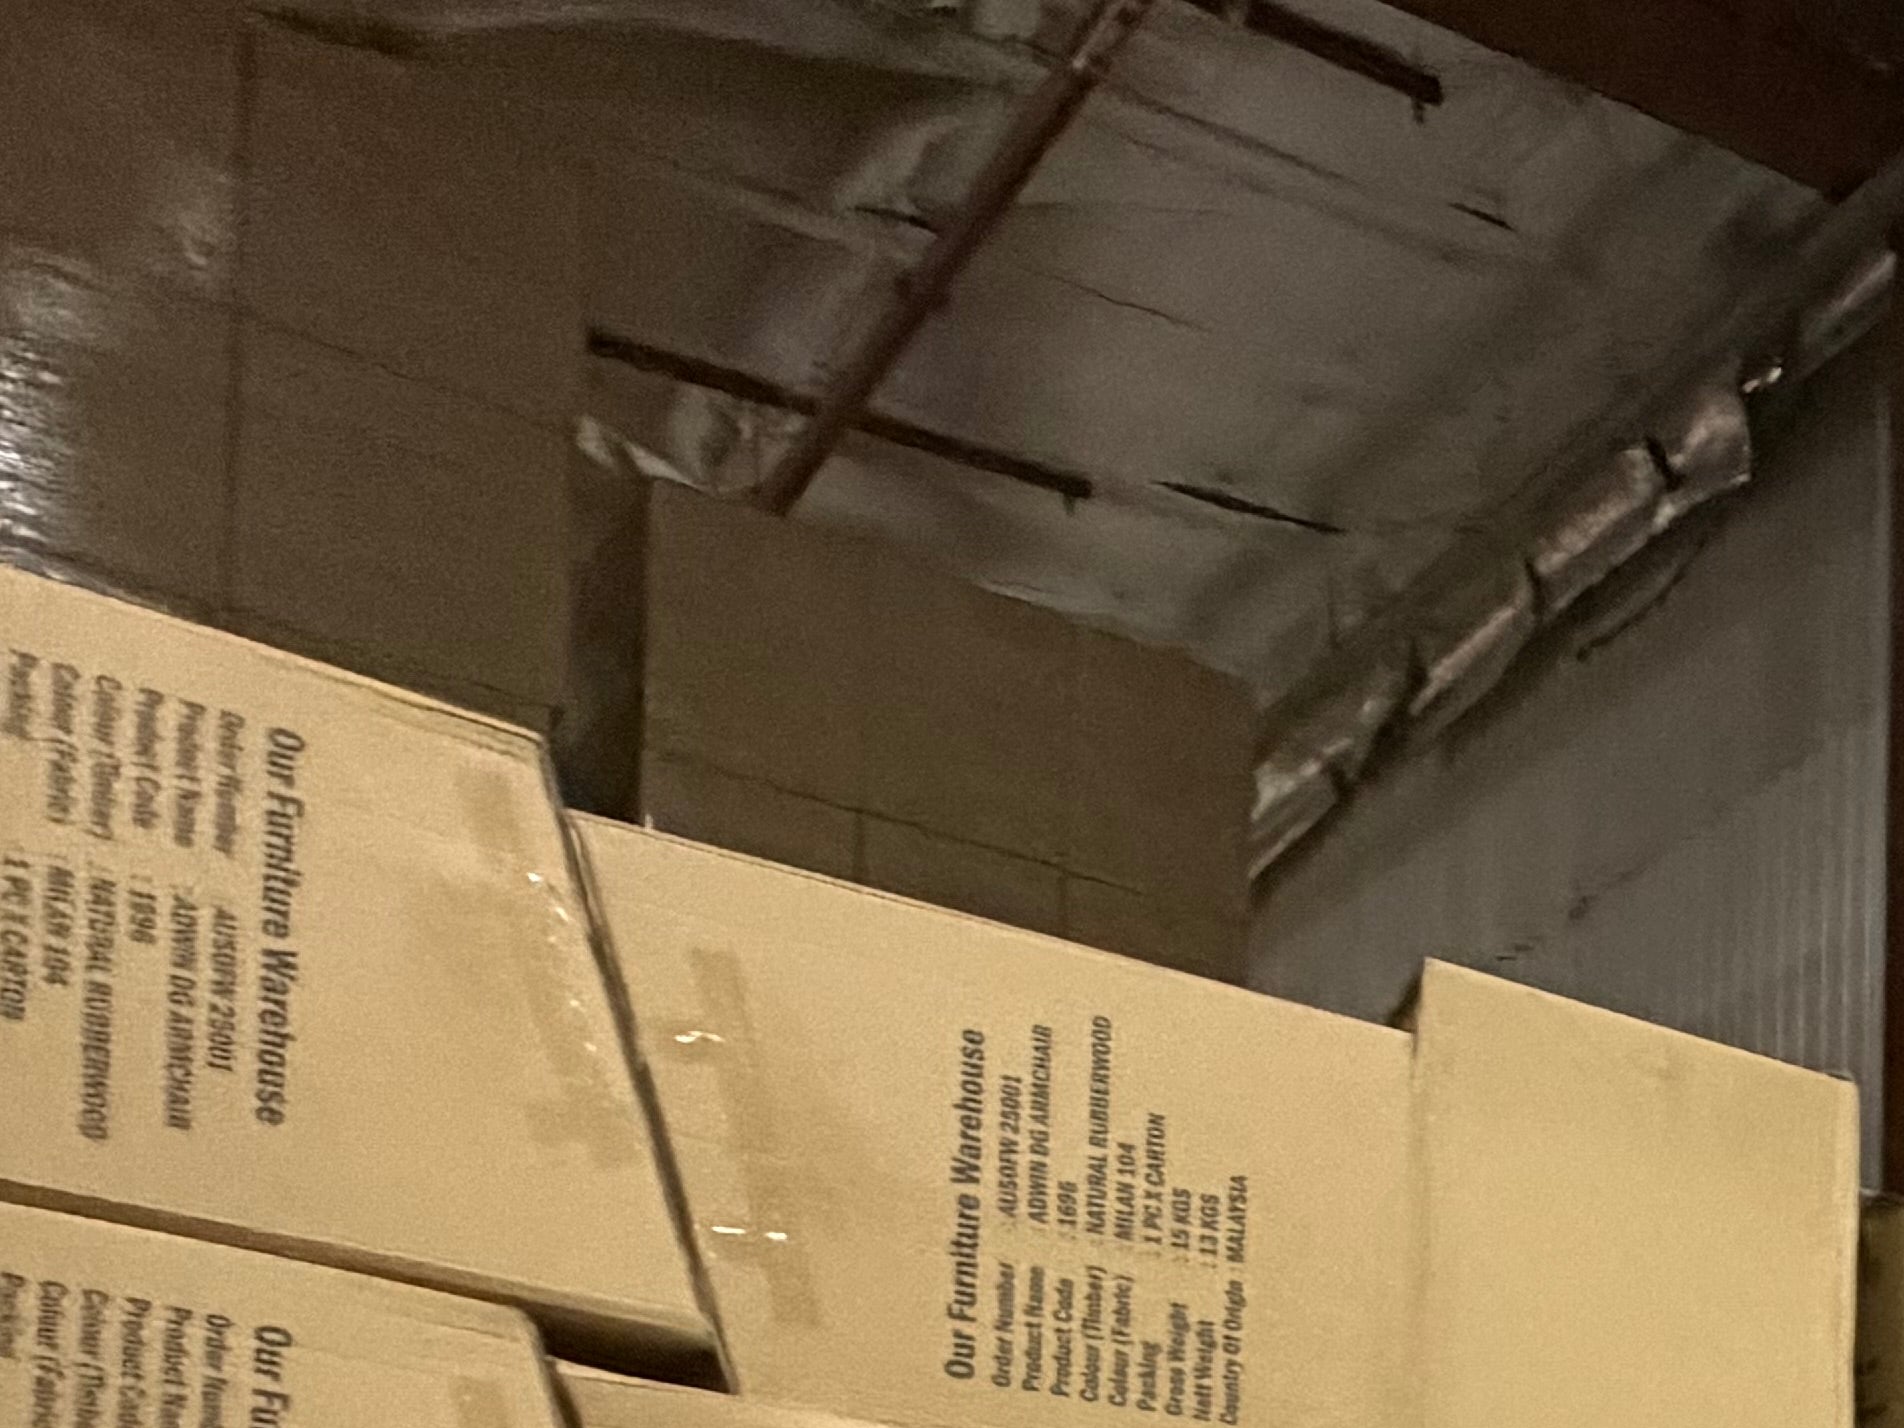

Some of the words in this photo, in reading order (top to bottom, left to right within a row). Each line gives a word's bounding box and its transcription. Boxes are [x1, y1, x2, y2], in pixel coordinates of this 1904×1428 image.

[266, 727, 306, 787] Our
[262, 792, 304, 939] Furniture
[255, 949, 297, 1125] Warehouse
[951, 1029, 985, 1184] Warehouse
[999, 1074, 1022, 1135] 25001
[1028, 1129, 1049, 1157] DG
[1116, 1142, 1136, 1177] 104
[1144, 1112, 1166, 1187] CARTON
[997, 1137, 1019, 1219] AUSOFW
[1027, 1160, 1048, 1224] ADWIN
[1056, 1180, 1078, 1228] 1696
[1085, 1155, 1108, 1235] NATURAL
[1143, 1189, 1163, 1202] X
[1171, 1187, 1192, 1226] KGS
[1113, 1181, 1136, 1242] MILAN
[1142, 1204, 1163, 1231] PC
[1142, 1234, 1162, 1246] 1
[1170, 1229, 1190, 1250] 15
[1199, 1193, 1220, 1231] KGS
[1225, 1175, 1248, 1264] MALAYSIA
[946, 1194, 980, 1322] Furniture
[1198, 1234, 1218, 1256] 13
[253, 1325, 293, 1382] Our
[943, 1329, 976, 1380] Our
